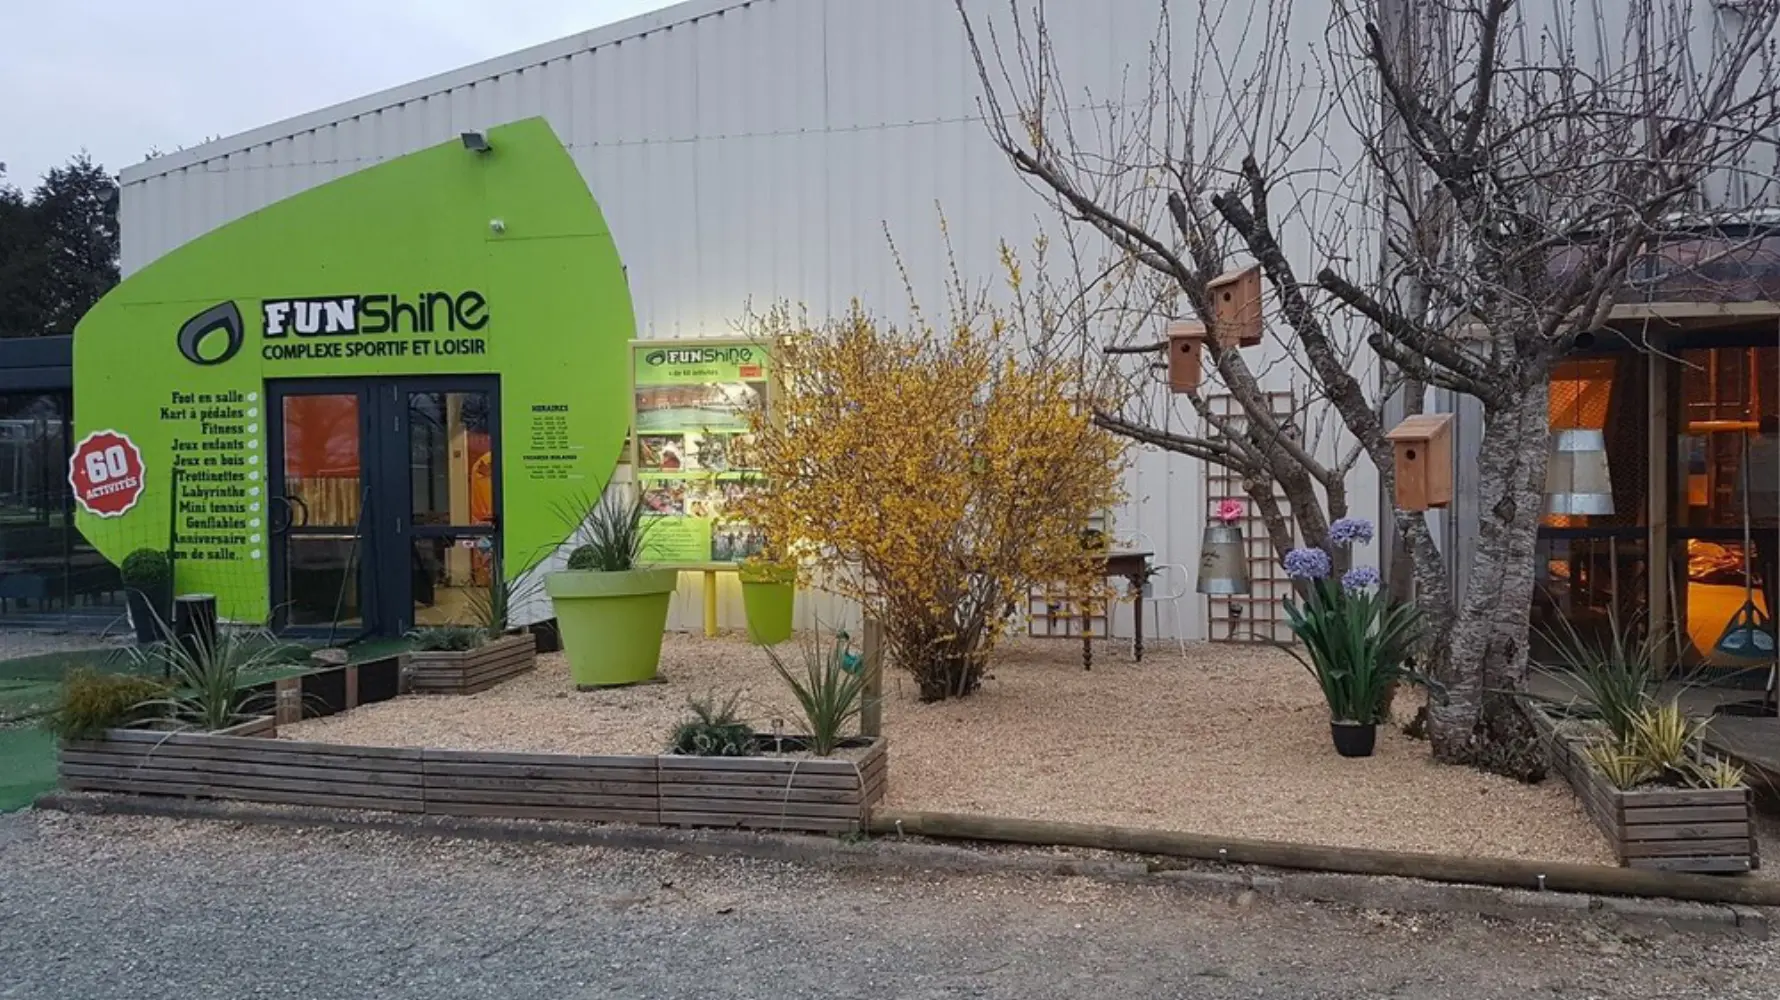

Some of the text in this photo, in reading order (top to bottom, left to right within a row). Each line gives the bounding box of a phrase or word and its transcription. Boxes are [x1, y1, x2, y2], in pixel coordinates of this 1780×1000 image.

[262, 338, 485, 359] COMPLEXE SPORTIF ET LOISIR
[172, 390, 244, 404] Foot en salle
[160, 406, 244, 421] Kart à pédales
[201, 423, 244, 435] Fitness
[171, 438, 244, 451] Jeux enfants
[173, 454, 244, 467] Jeux en bois
[179, 469, 245, 482] Trottinettes
[181, 485, 245, 501] Labyrinthe
[179, 501, 246, 513] Mini tennis
[186, 516, 246, 529] Gonflables
[191, 547, 204, 559] de
